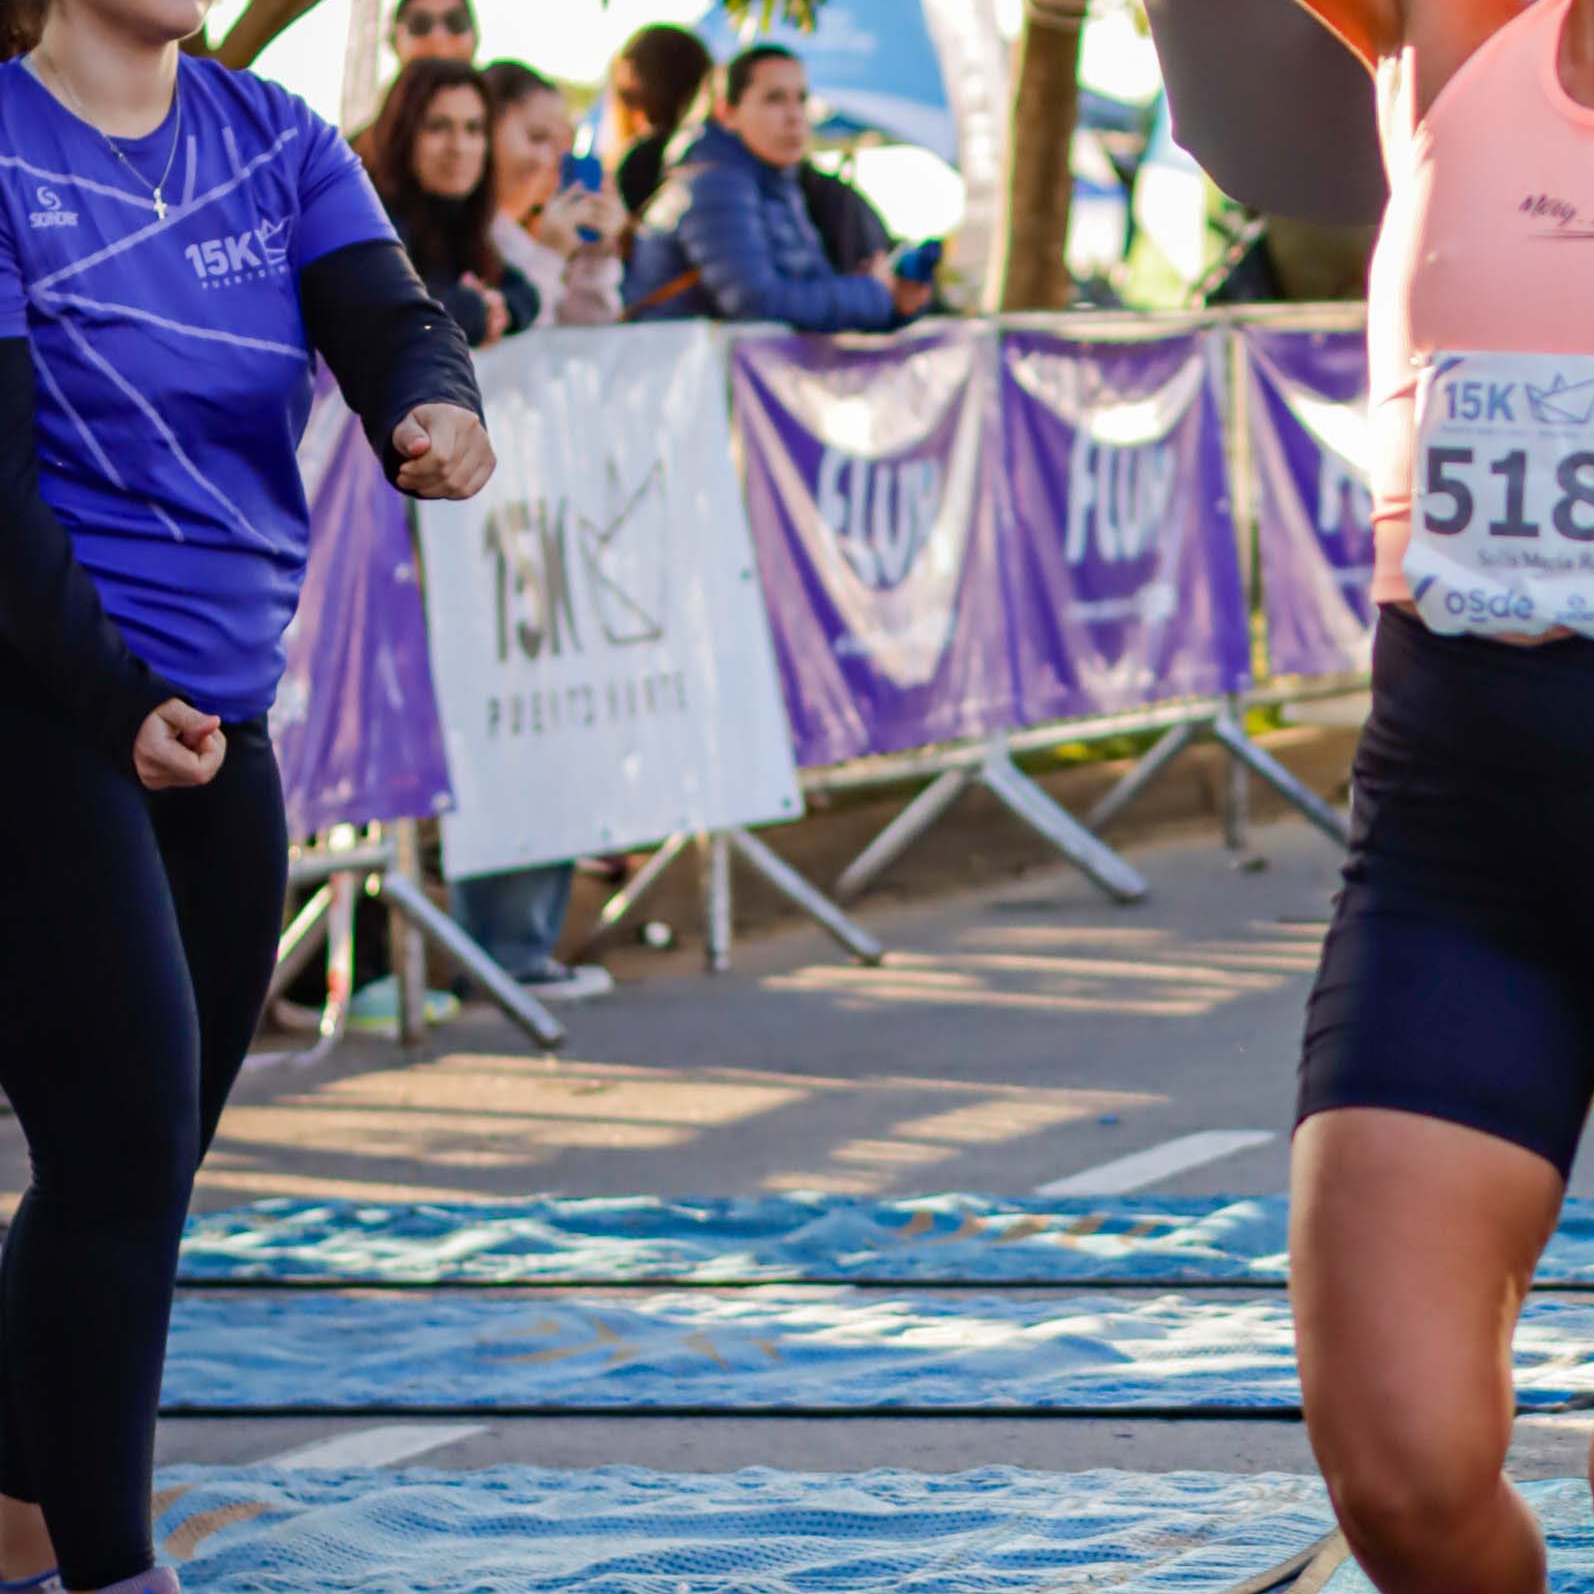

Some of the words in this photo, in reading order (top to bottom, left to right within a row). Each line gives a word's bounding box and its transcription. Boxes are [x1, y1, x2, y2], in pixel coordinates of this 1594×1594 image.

[185, 231, 261, 278] 15K
[1445, 381, 1516, 422] 15K
[1445, 587, 1535, 619] osde
